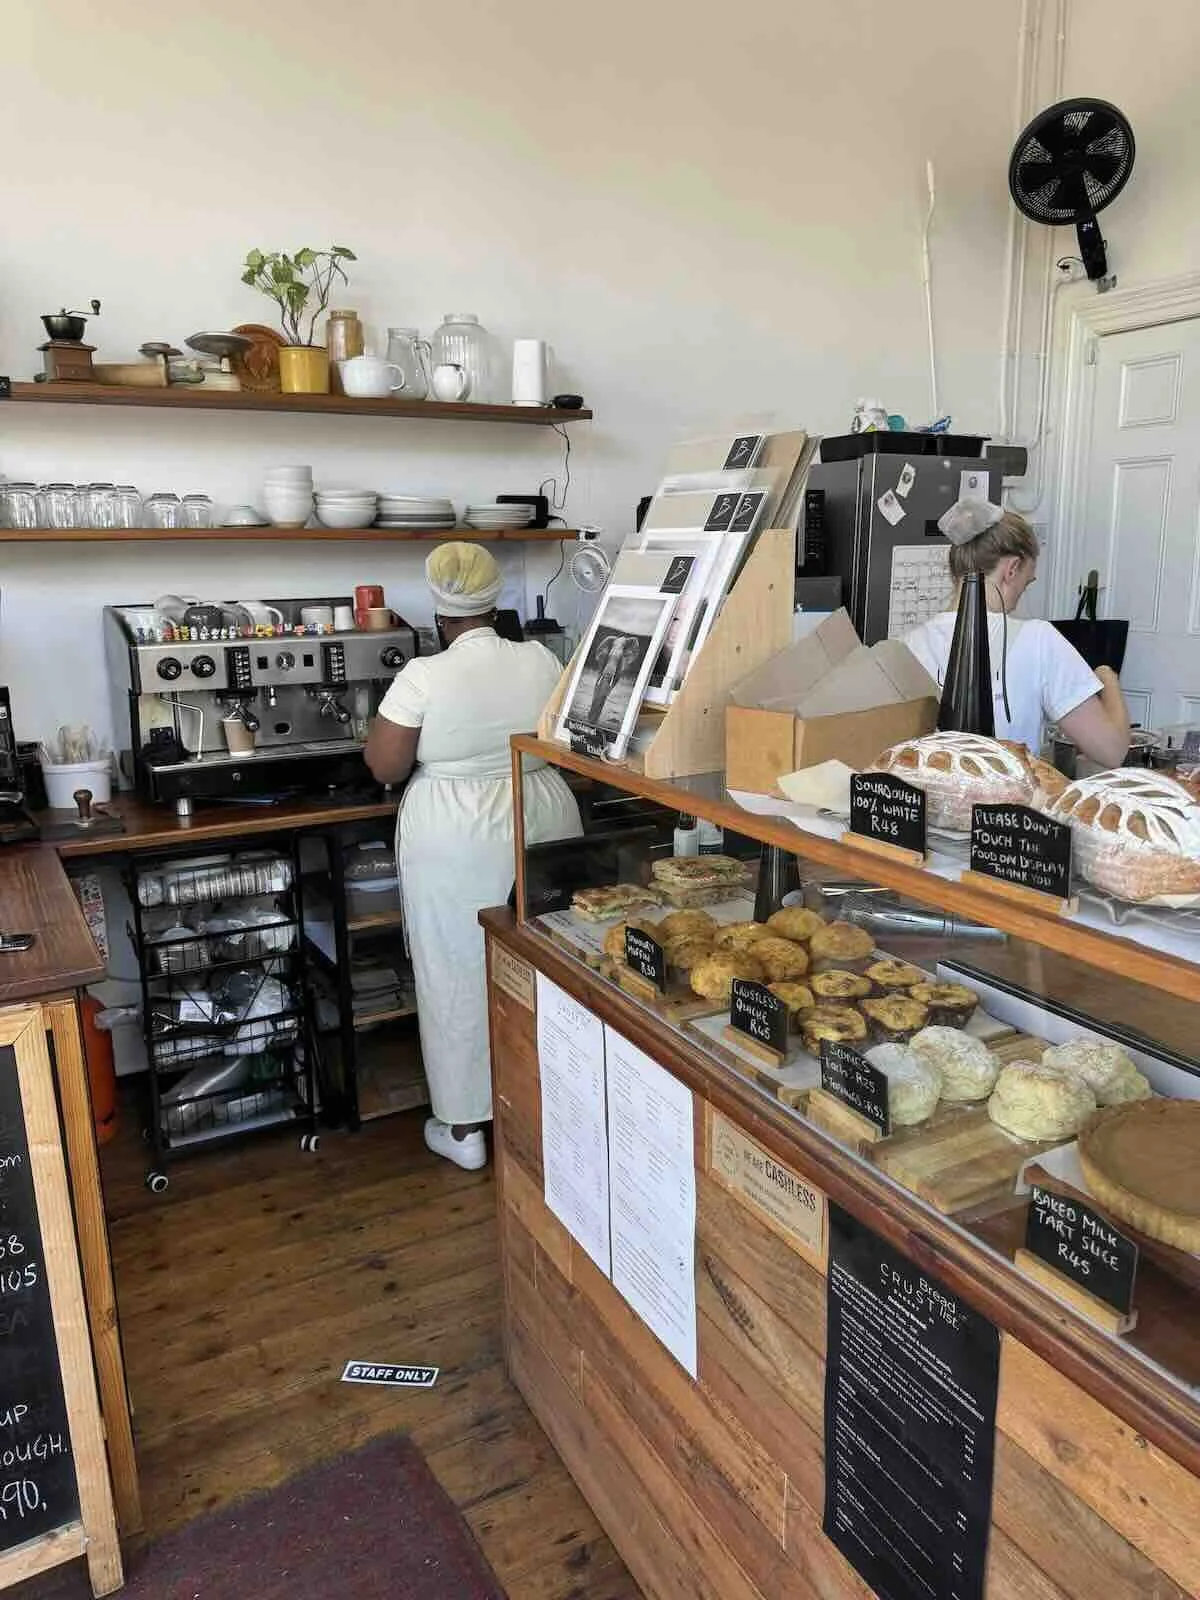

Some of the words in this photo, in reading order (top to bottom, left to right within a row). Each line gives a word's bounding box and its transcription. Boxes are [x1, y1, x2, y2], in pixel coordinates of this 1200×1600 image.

[855, 775, 921, 806] SOURDOUGH
[853, 795, 877, 813] 100%
[883, 803, 920, 822] WHITE
[975, 809, 1020, 828] PLEASE
[871, 814, 899, 836] R48
[973, 829, 1013, 848] TOUCH
[999, 854, 1017, 866] ON
[641, 961, 656, 977] R30
[765, 1160, 816, 1211] CASHLESS
[1033, 1187, 1076, 1222] BAKED
[1082, 1215, 1117, 1248] MILK
[1035, 1207, 1075, 1241] TART
[1081, 1236, 1119, 1272] SLICE
[1058, 1243, 1091, 1274] R45
[880, 1263, 935, 1312] CRUST
[919, 1277, 956, 1315] Bread
[351, 1366, 393, 1379] STAFF
[395, 1369, 430, 1382] ONLY
